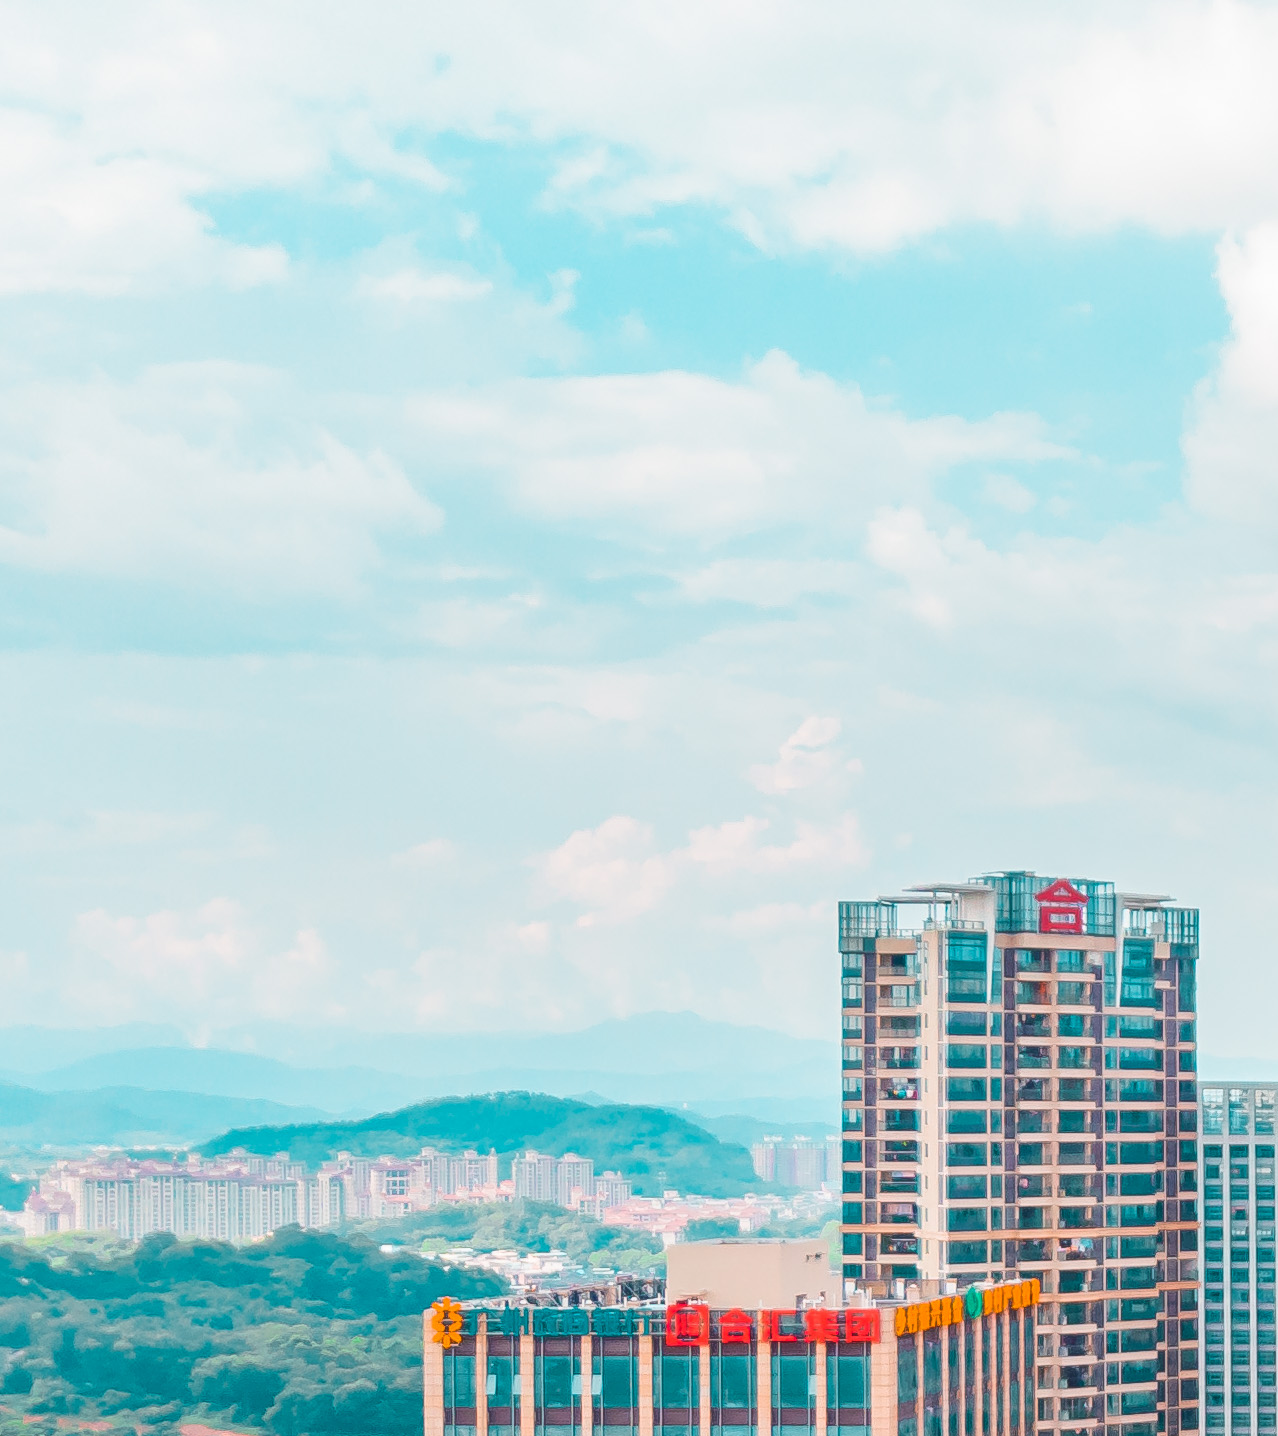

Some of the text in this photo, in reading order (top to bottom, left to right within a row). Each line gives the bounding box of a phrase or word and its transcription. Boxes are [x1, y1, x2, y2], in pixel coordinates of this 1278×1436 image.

[1034, 879, 1089, 933] 合
[719, 1308, 880, 1344] 合汇集团
